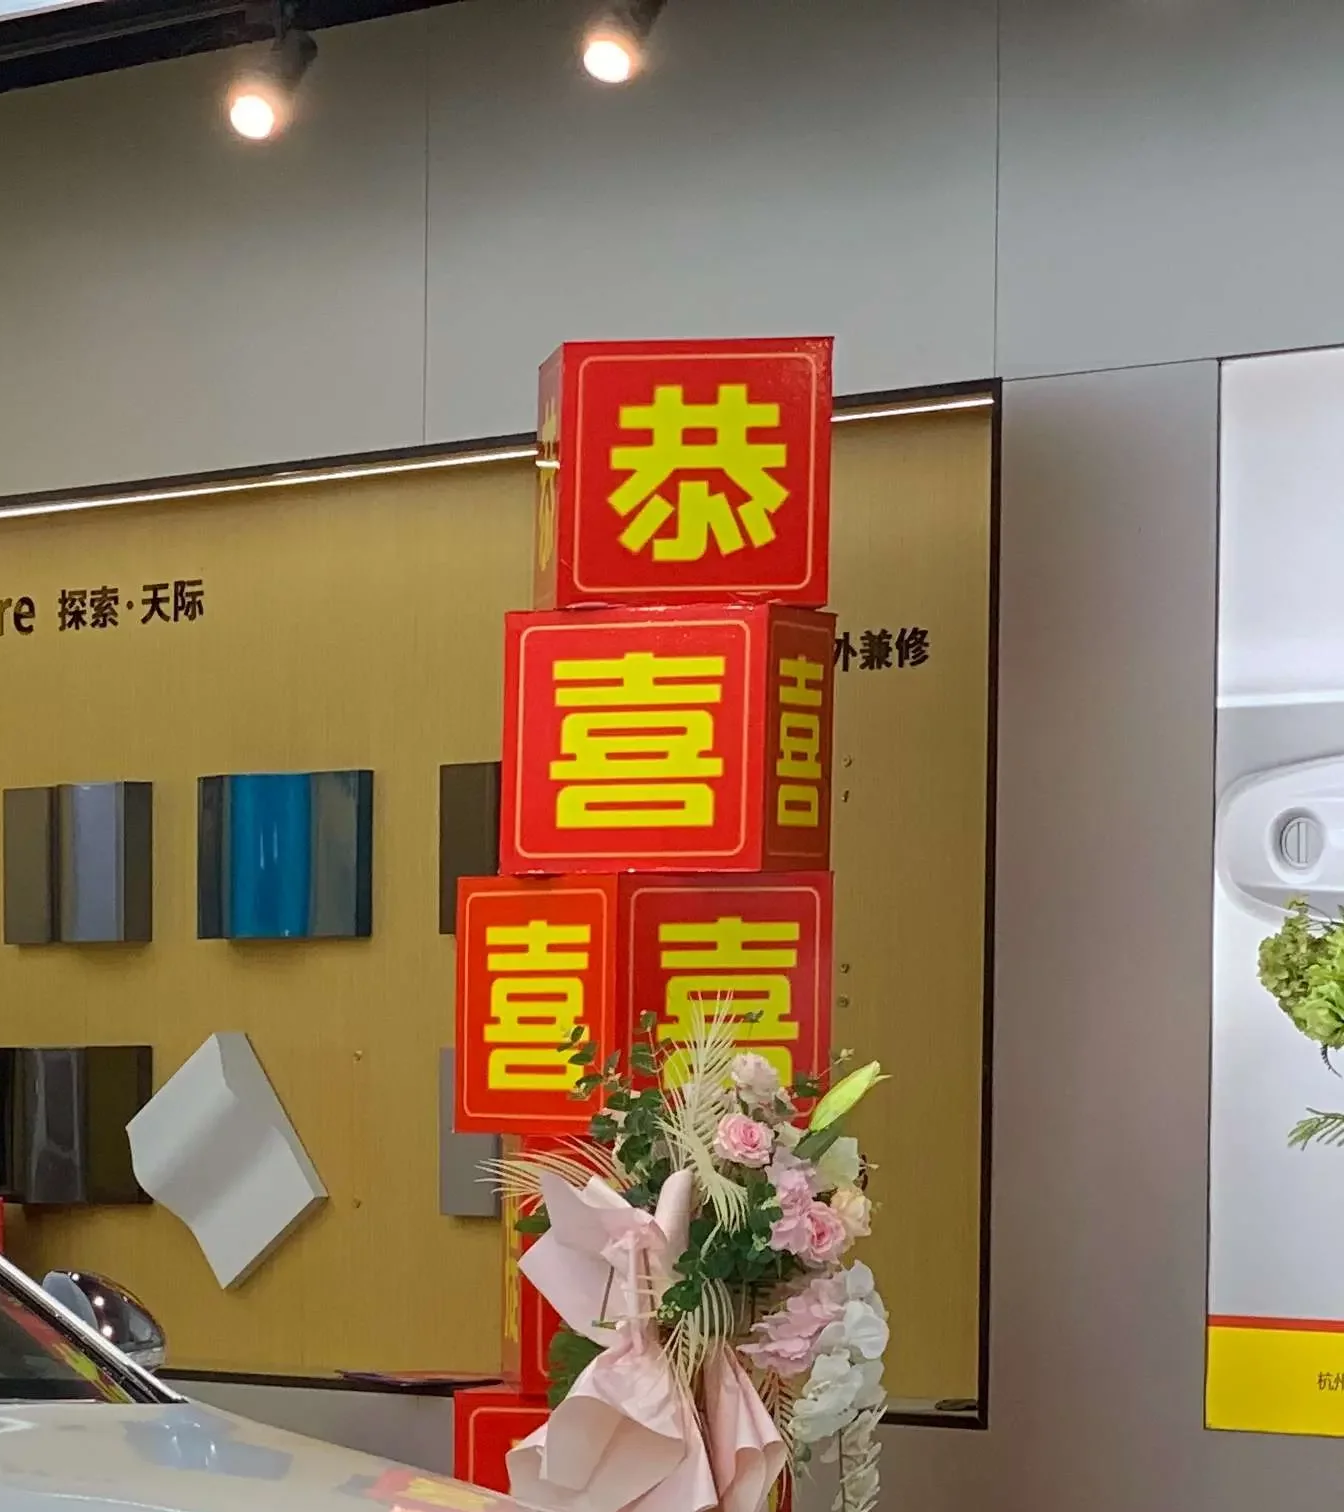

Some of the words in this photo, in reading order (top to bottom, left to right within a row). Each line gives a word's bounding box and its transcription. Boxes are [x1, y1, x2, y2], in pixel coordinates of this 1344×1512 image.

[607, 383, 790, 562] 恭
[549, 651, 726, 829] 喜
[775, 655, 825, 828] 喜
[483, 919, 592, 1091] 喜
[657, 916, 801, 1089] 喜
